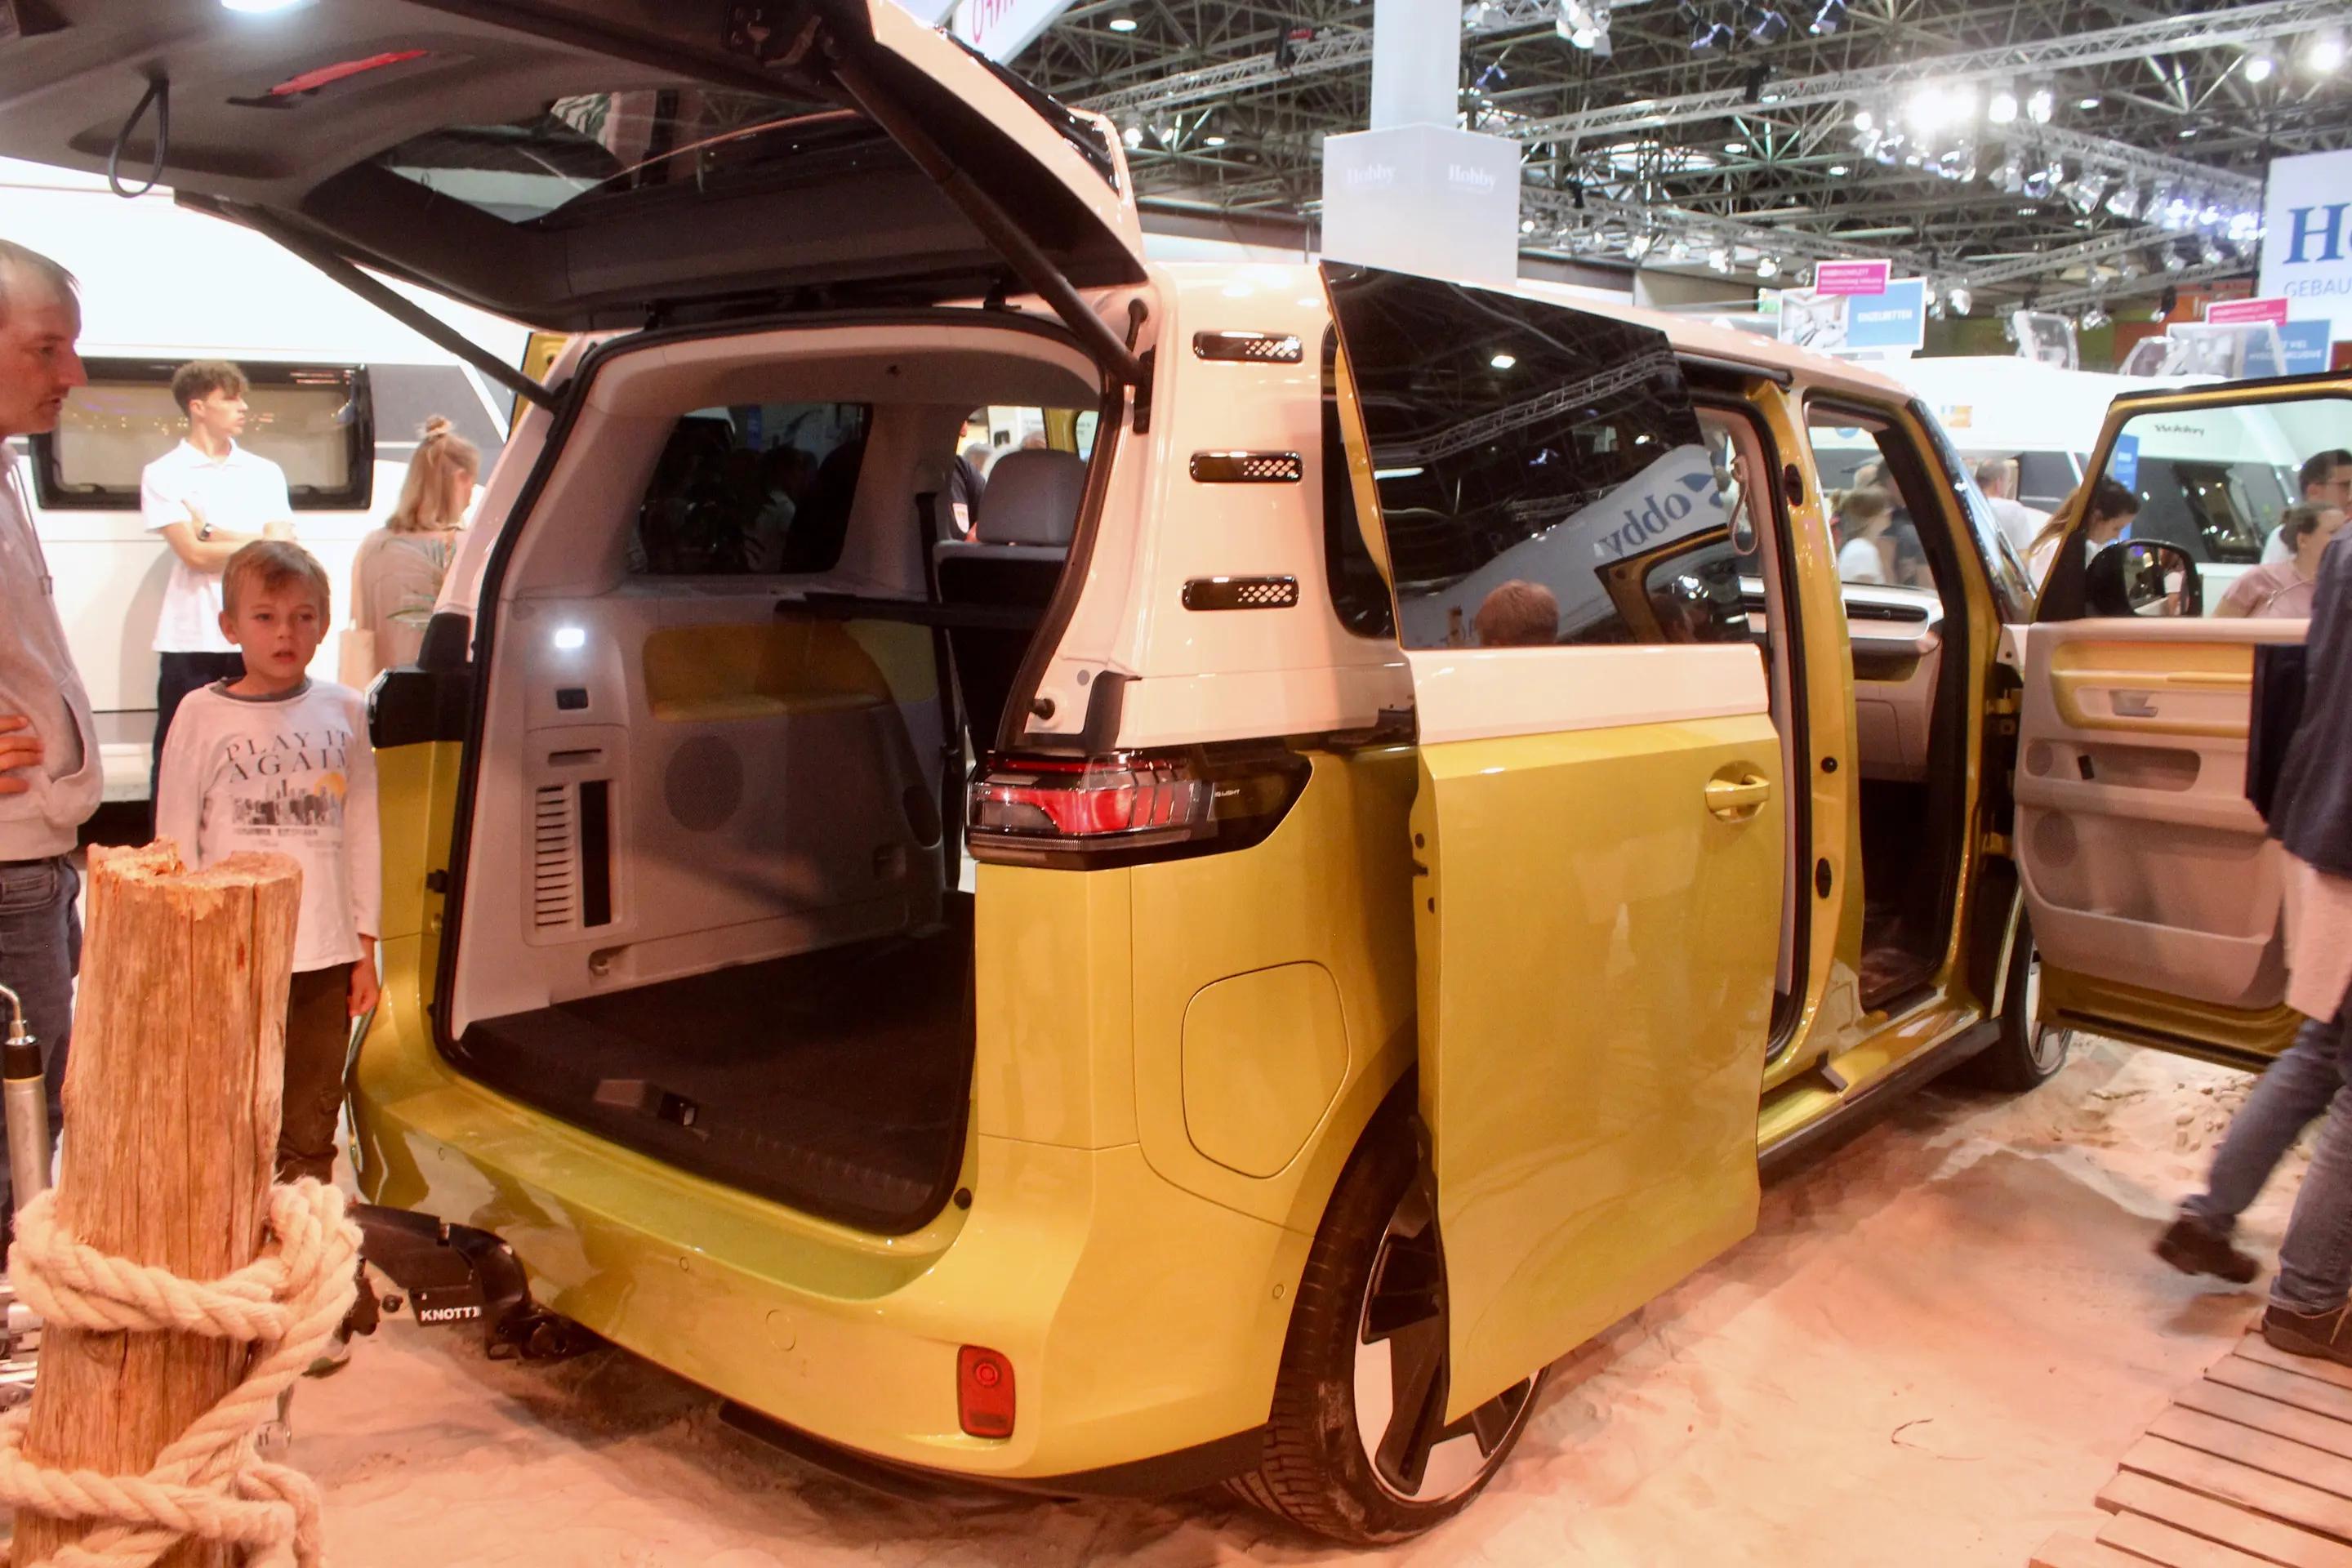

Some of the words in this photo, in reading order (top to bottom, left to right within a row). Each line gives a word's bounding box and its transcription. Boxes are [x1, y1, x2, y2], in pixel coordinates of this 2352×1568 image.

[1449, 163, 1496, 192] Hobby
[2283, 203, 2352, 265] H
[226, 732, 310, 761] PLAY
